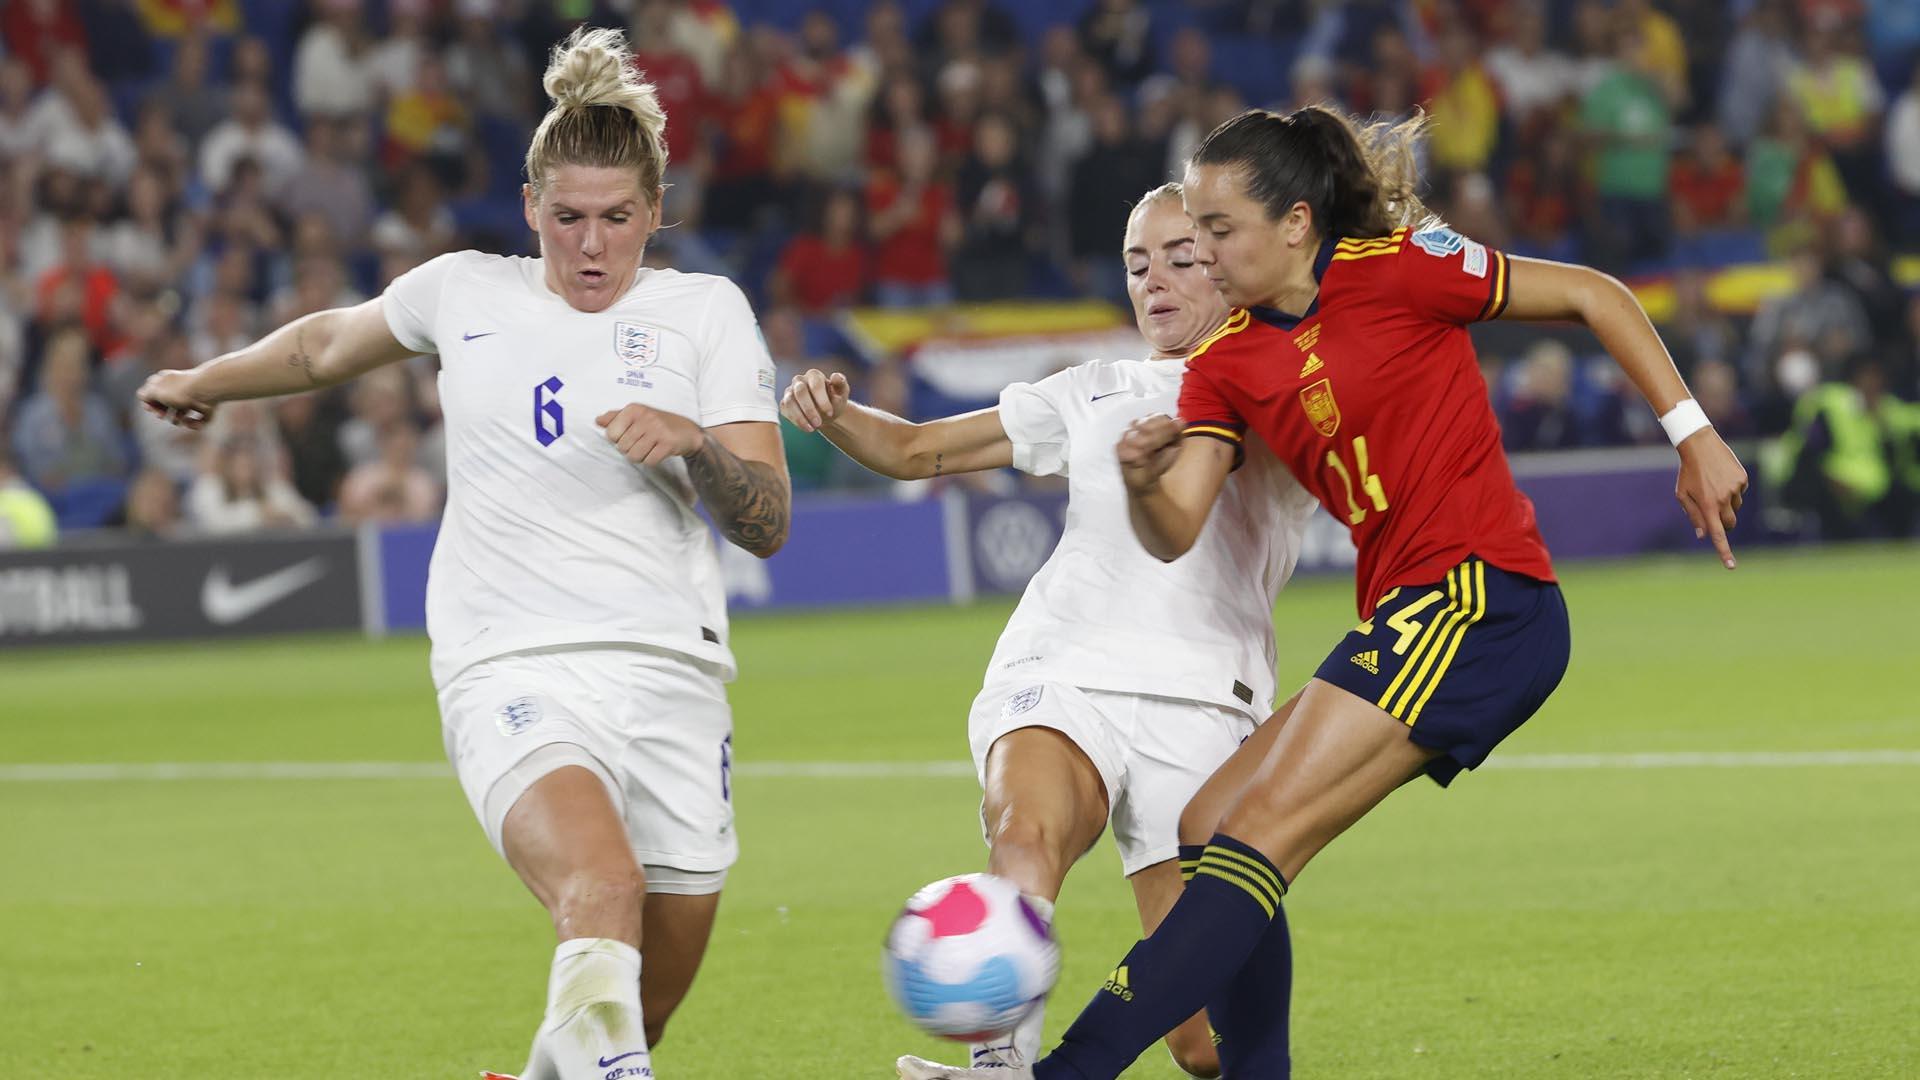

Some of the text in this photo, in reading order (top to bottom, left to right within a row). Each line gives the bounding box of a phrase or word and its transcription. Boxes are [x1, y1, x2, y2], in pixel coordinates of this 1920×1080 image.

[534, 375, 564, 447] 6
[1326, 435, 1389, 525] 14
[1350, 655, 1380, 675] adidas
